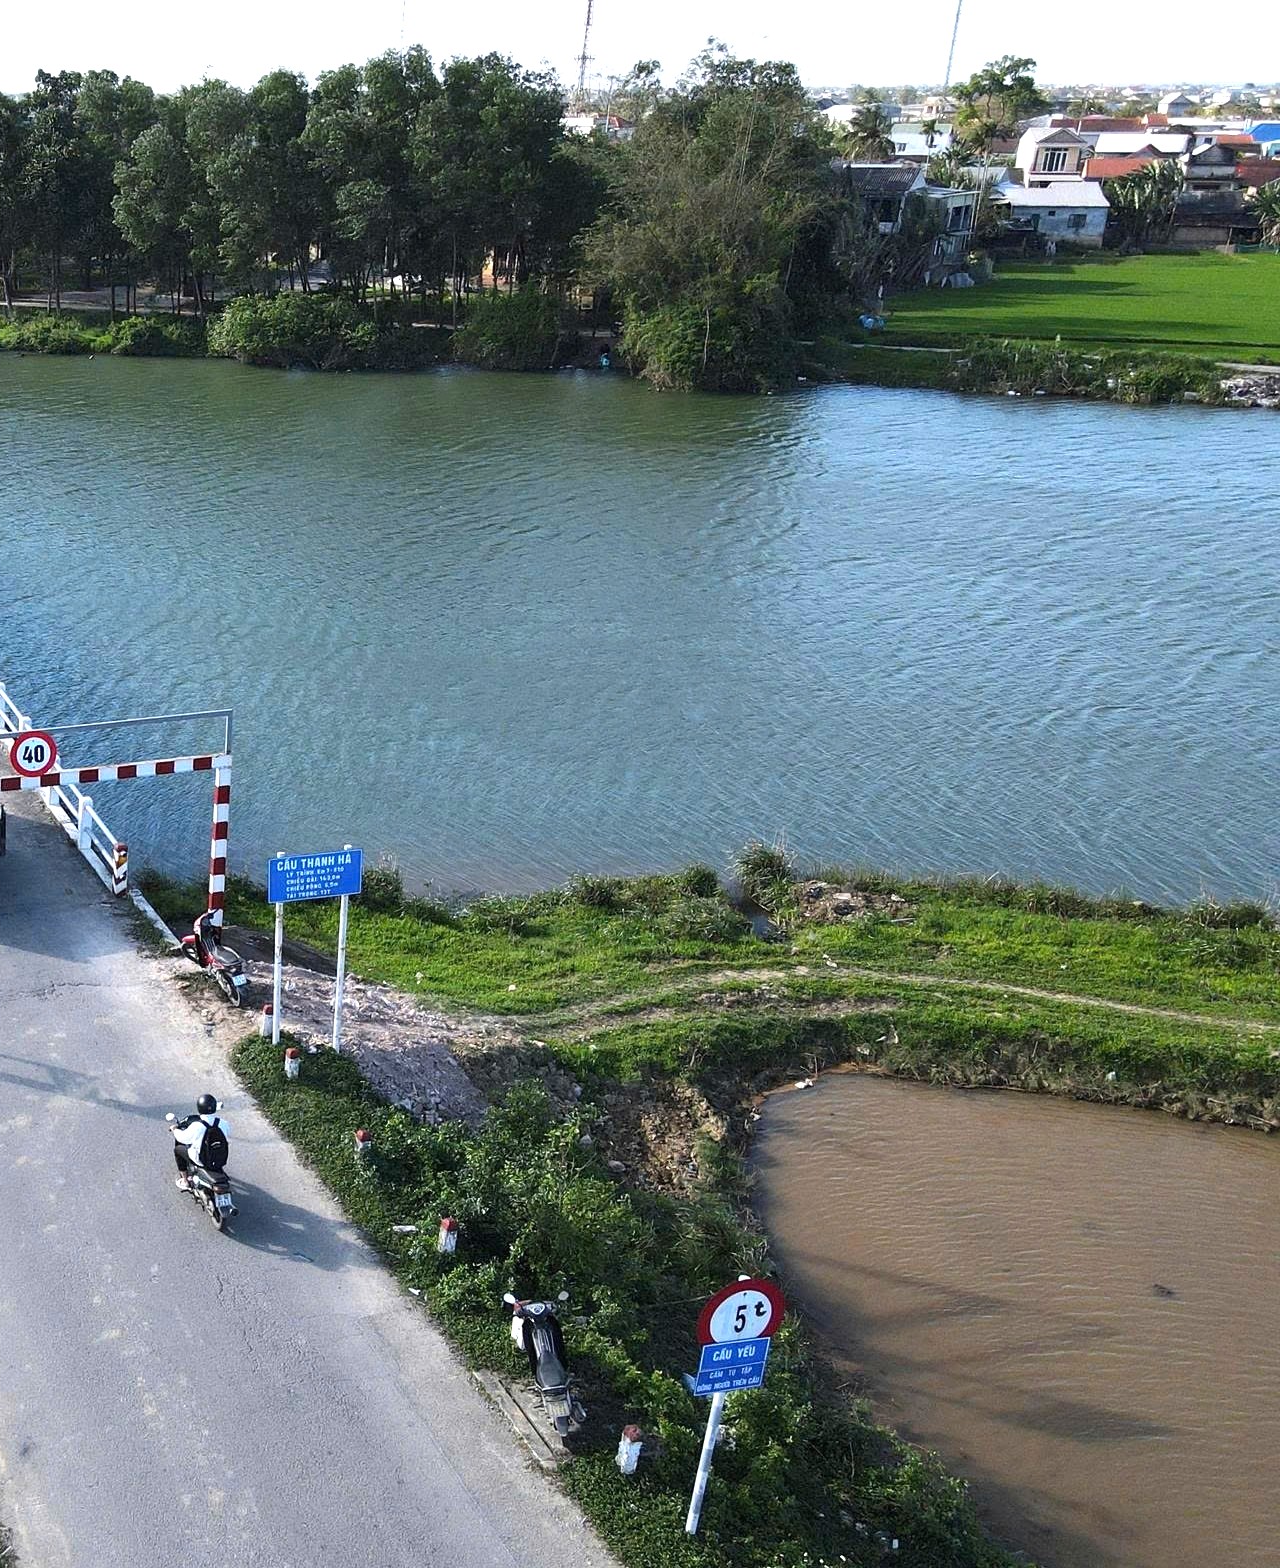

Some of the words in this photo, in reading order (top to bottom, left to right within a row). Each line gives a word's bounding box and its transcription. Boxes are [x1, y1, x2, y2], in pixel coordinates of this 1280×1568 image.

[22, 744, 45, 763] 40
[301, 856, 335, 868] THANH
[338, 853, 352, 865] HÀ
